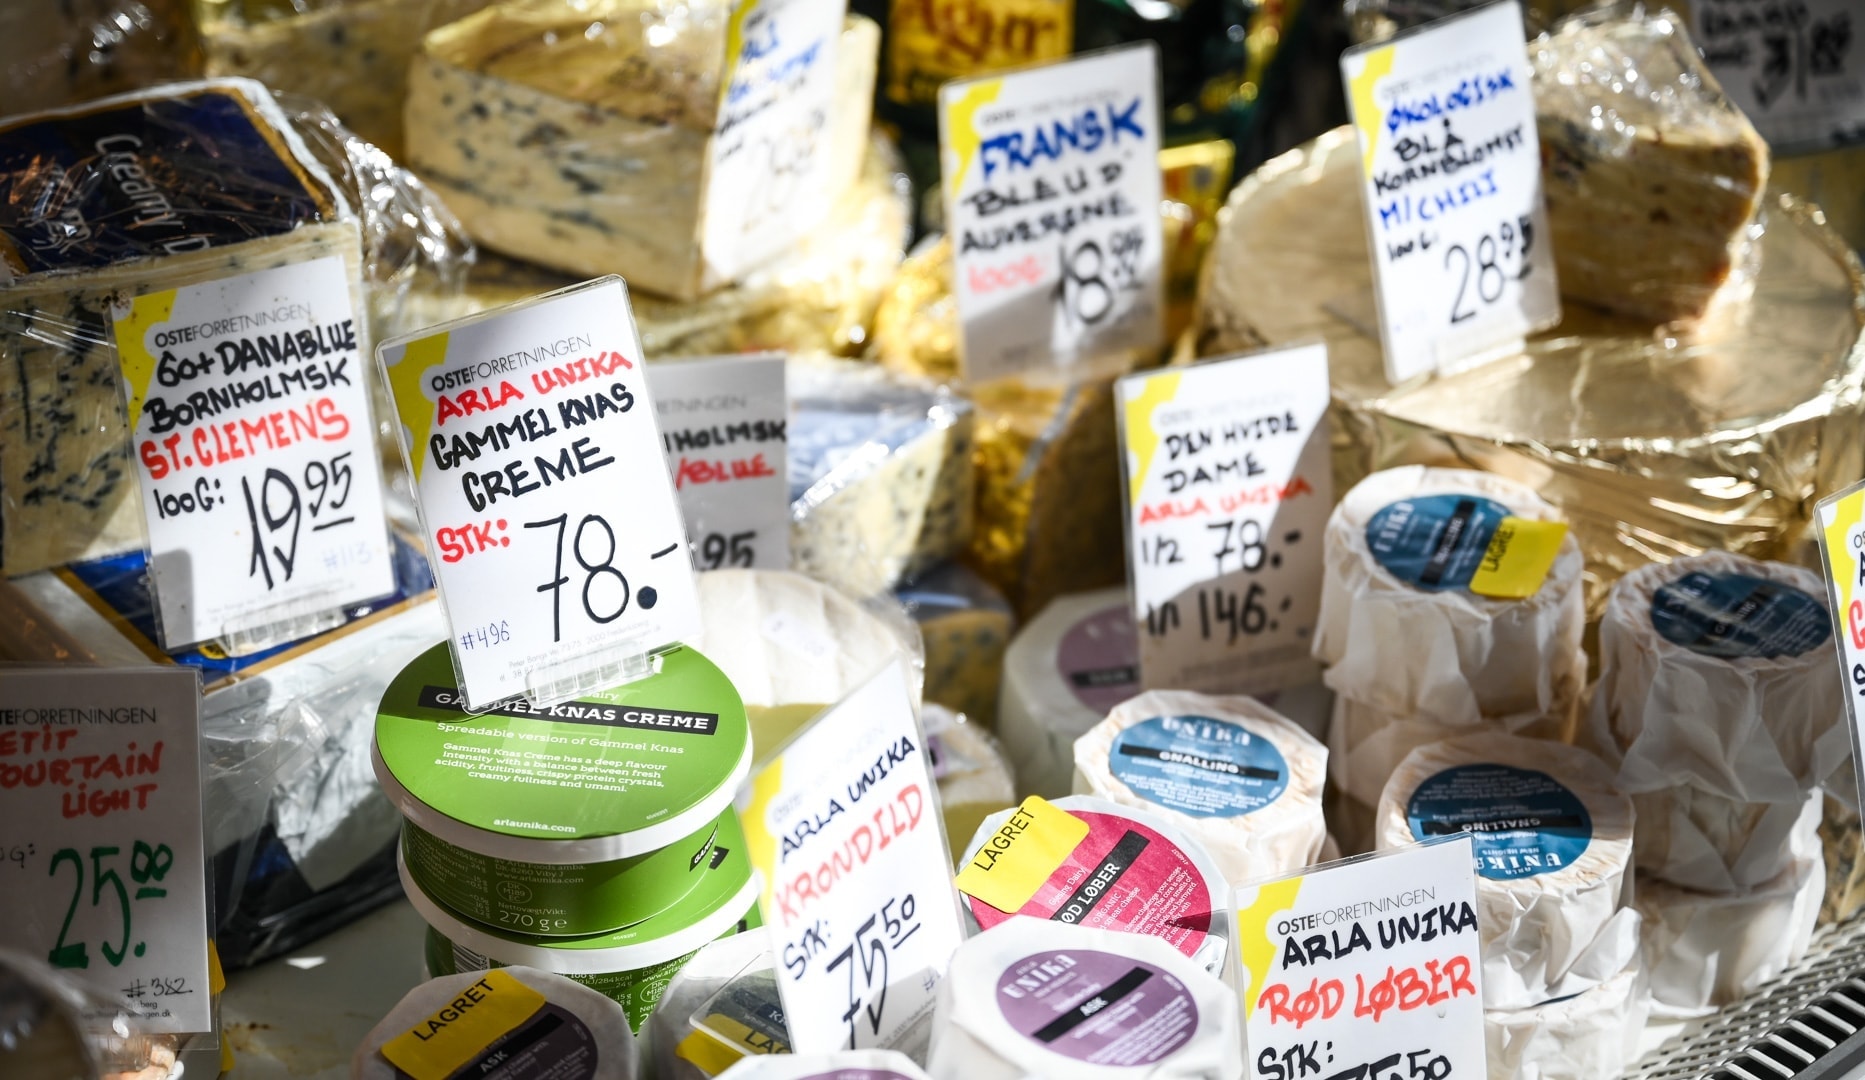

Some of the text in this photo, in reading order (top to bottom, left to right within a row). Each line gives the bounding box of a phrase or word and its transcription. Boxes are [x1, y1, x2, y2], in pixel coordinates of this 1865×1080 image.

[980, 98, 1145, 182] FRANSK
[1394, 118, 1463, 163] BLÅ
[95, 134, 184, 226] Creamy
[155, 302, 312, 348] OSTEFORRETNINGEN
[215, 318, 358, 376] DANABLUE
[431, 333, 592, 392] OSTEFORRETNINGEN
[143, 357, 351, 434] BORNHOLMSK
[437, 351, 633, 427] ARLA UNIKA
[430, 382, 635, 470] GAMMEL KNAS
[1165, 428, 1212, 461] DEN
[1224, 410, 1299, 442] HVIDE
[462, 437, 615, 512] CREME
[1163, 453, 1265, 494] DAME
[1140, 497, 1210, 526] ARLA
[436, 518, 510, 563] STK:
[460, 620, 510, 650] #496
[548, 704, 616, 721] KNAS
[623, 711, 709, 730] CREME
[437, 722, 685, 754] Spreadable version of Gammel Knas
[434, 758, 476, 770] acidity,
[536, 770, 570, 780] crispy
[573, 772, 615, 783] protein
[618, 777, 664, 788] crystals,
[443, 742, 491, 755] Gammel
[493, 748, 521, 758] Knas
[523, 751, 561, 762] Creme
[563, 755, 583, 764] has
[595, 758, 623, 768] deep
[625, 760, 667, 771] flavour
[495, 757, 521, 766] with
[533, 760, 577, 771] balance
[580, 764, 629, 777] between
[631, 769, 661, 779] fresh
[1159, 750, 1240, 774] GNALLING
[468, 770, 627, 792] creamy fullness and umami.
[61, 783, 158, 819] LIGHT
[780, 797, 847, 864] ARLA
[847, 735, 916, 802] UNIKA
[493, 817, 576, 834] arlaunika.com
[973, 807, 1035, 872] LAGRET
[1461, 818, 1541, 833] GNALLING
[774, 782, 925, 928] KRONDILD
[495, 872, 584, 884] www.arlaunika.com
[1057, 862, 1121, 925] ØD LØBER
[1066, 866, 1087, 887] Dairy
[1093, 892, 1122, 923] ORGANIC
[1120, 887, 1141, 908] cheese
[1138, 893, 1159, 916] challenge
[1156, 880, 1169, 895] your
[1151, 911, 1162, 923] The
[1160, 896, 1176, 914] cheese
[1154, 898, 1164, 910] The
[1162, 886, 1174, 901] core
[1168, 904, 1179, 915] and
[1180, 902, 1192, 915] with
[1277, 886, 1436, 936] OSTEFORRETNINGEN
[500, 910, 550, 931] 270 g
[1282, 901, 1478, 970] ARLA UNIKA
[412, 978, 494, 1041] LAGRET
[1258, 977, 1345, 1030] RØD
[1353, 955, 1477, 1023] LØBER
[479, 1049, 510, 1073] ASK
